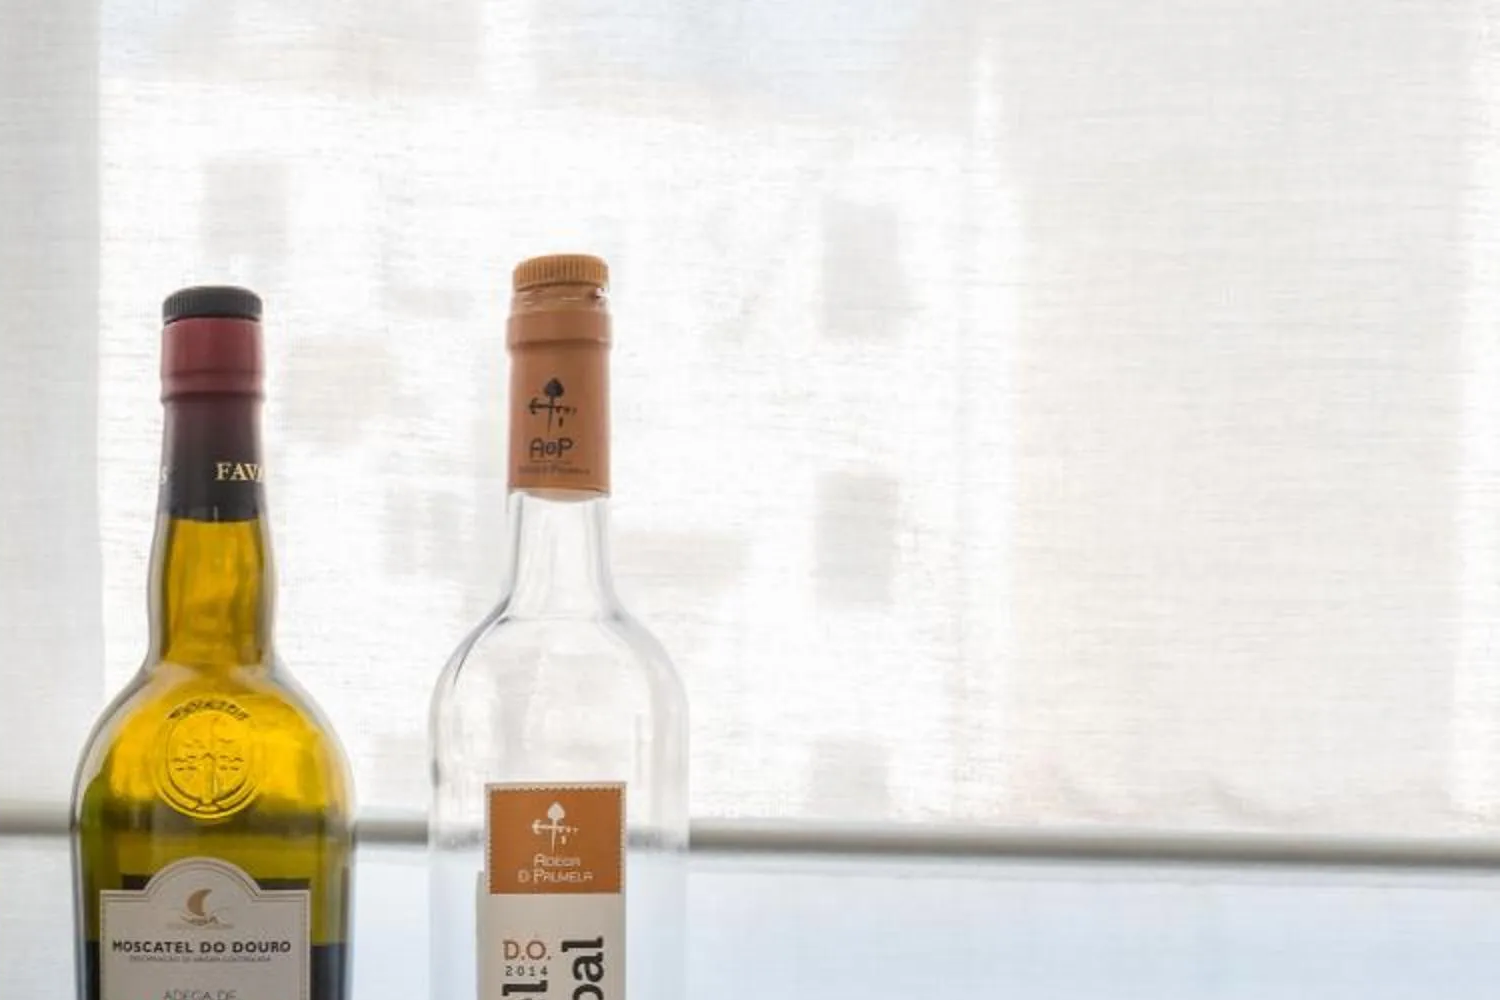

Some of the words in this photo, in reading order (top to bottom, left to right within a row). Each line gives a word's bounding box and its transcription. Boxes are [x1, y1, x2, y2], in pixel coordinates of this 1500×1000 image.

[112, 941, 193, 953] MOSCATEL
[201, 941, 226, 953] DO
[232, 941, 292, 953] DOURO
[502, 939, 552, 960] D.O.
[504, 965, 549, 977] 2014
